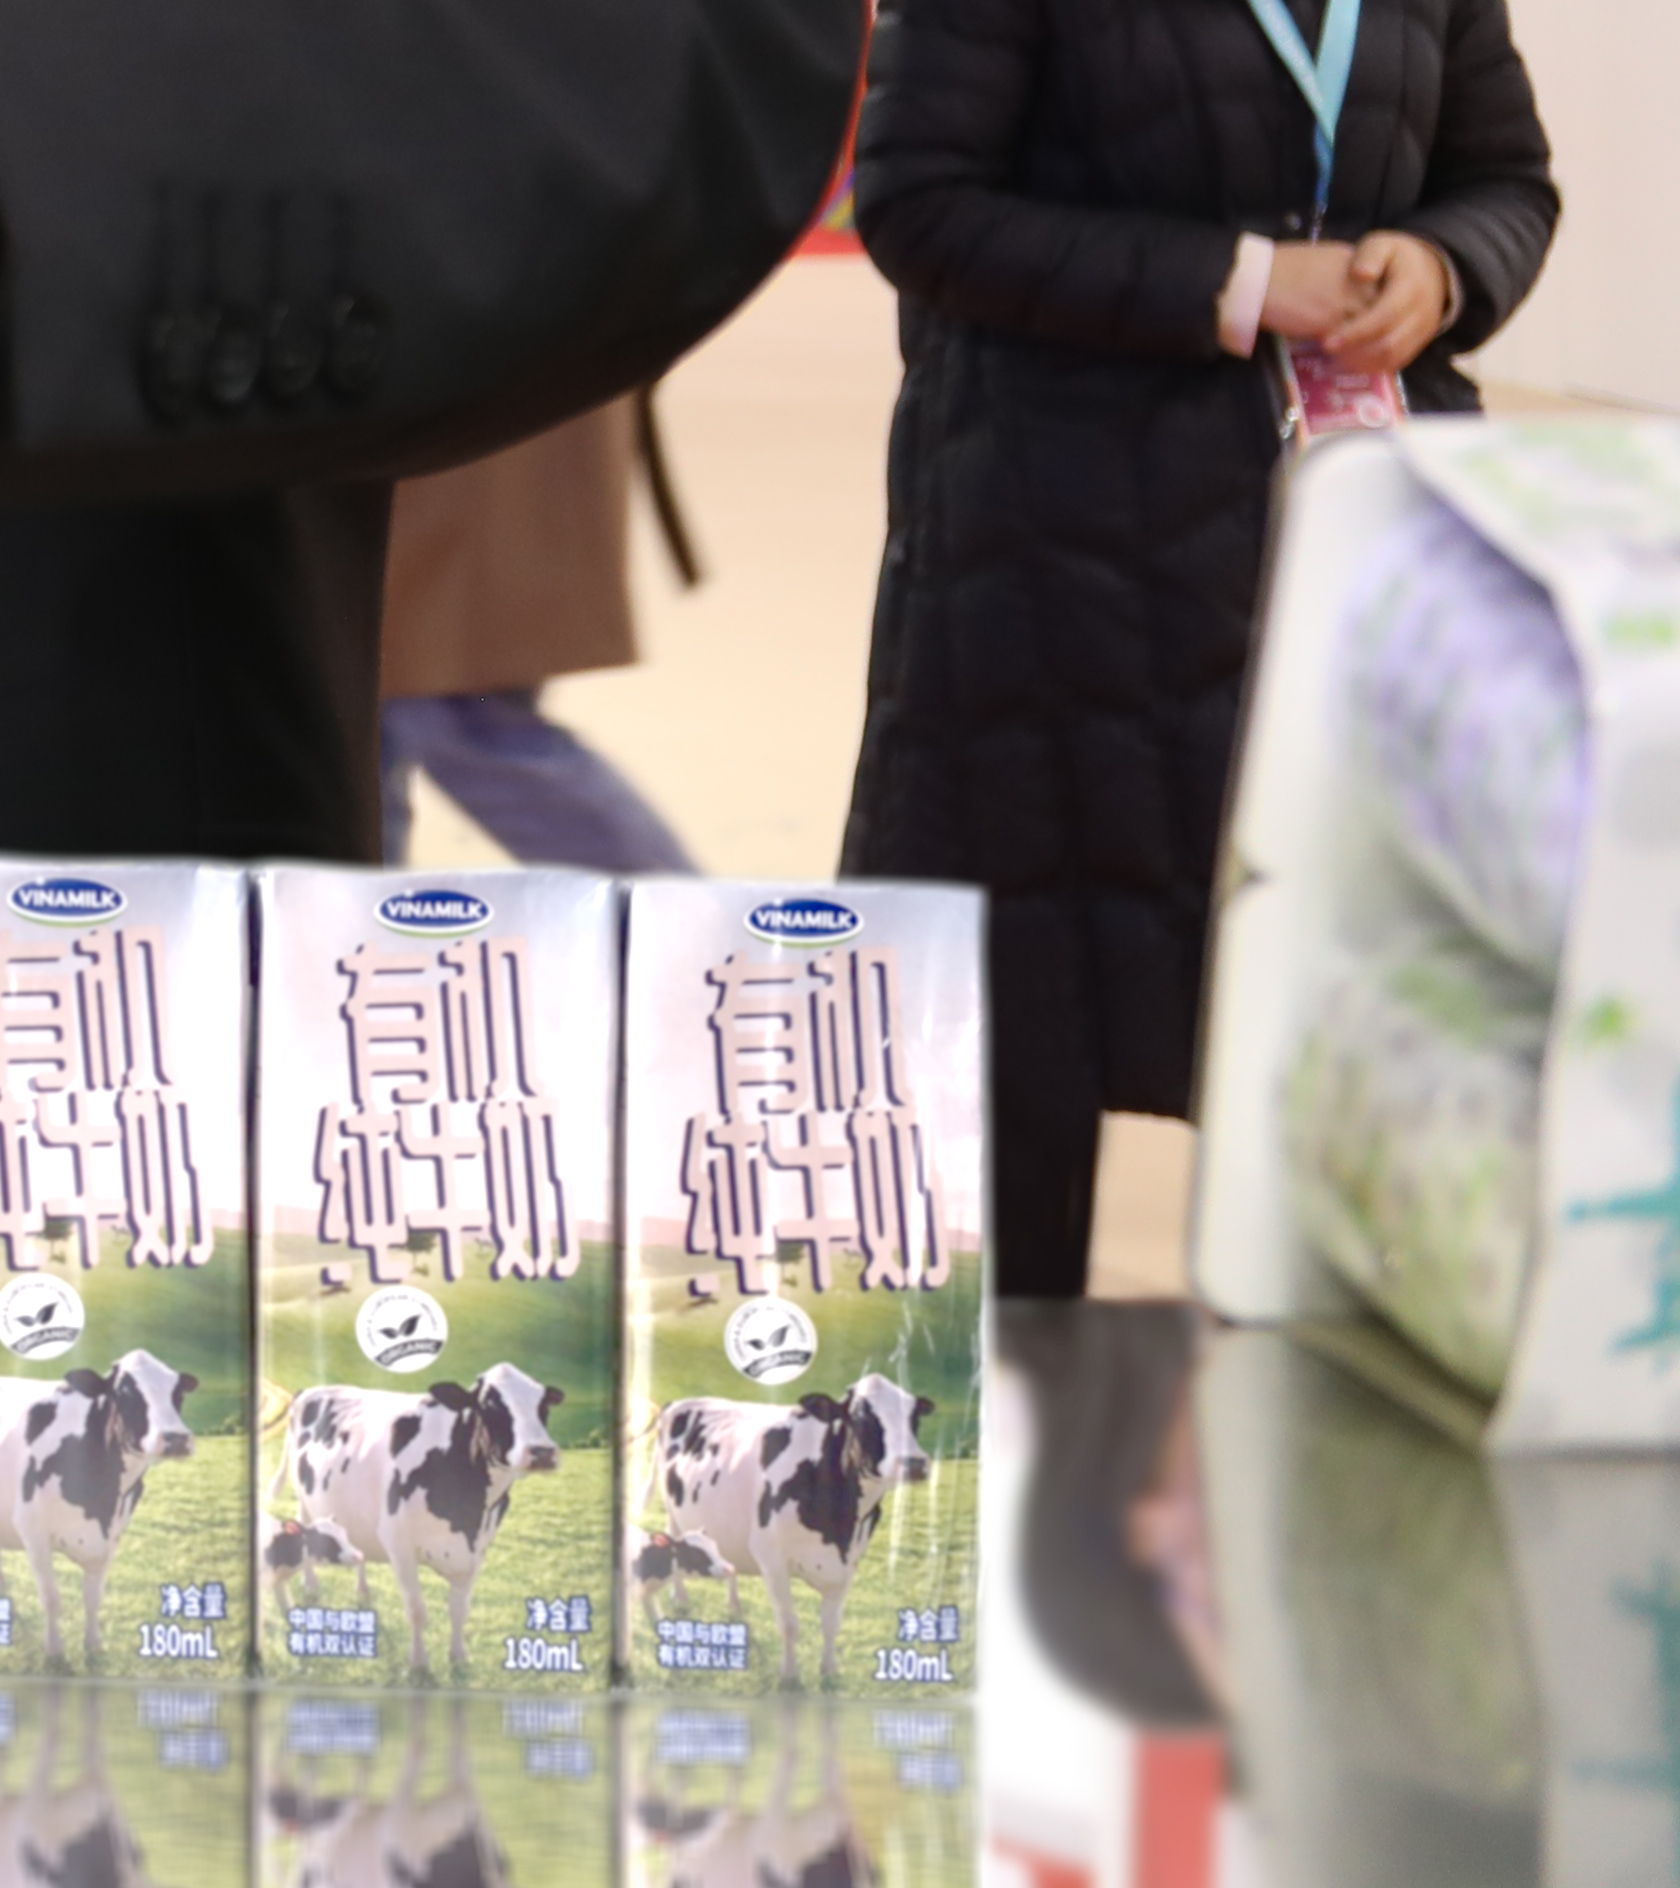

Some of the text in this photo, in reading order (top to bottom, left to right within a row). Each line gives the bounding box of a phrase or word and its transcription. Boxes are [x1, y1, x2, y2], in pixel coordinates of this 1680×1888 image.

[335, 933, 545, 1106] 有机
[705, 945, 915, 1116] 有机
[313, 1096, 580, 1288] 纯牛奶
[681, 1106, 950, 1297] 纯牛奶
[161, 1582, 226, 1617] 净含量
[527, 1596, 590, 1631] 净含量
[289, 1609, 376, 1633] 中国与欧盟
[658, 1621, 746, 1645] 中国与欧盟
[898, 1606, 960, 1641] 净含量
[139, 1624, 218, 1657] 180mL
[504, 1638, 583, 1670] 180mL
[875, 1649, 953, 1680] 180mL
